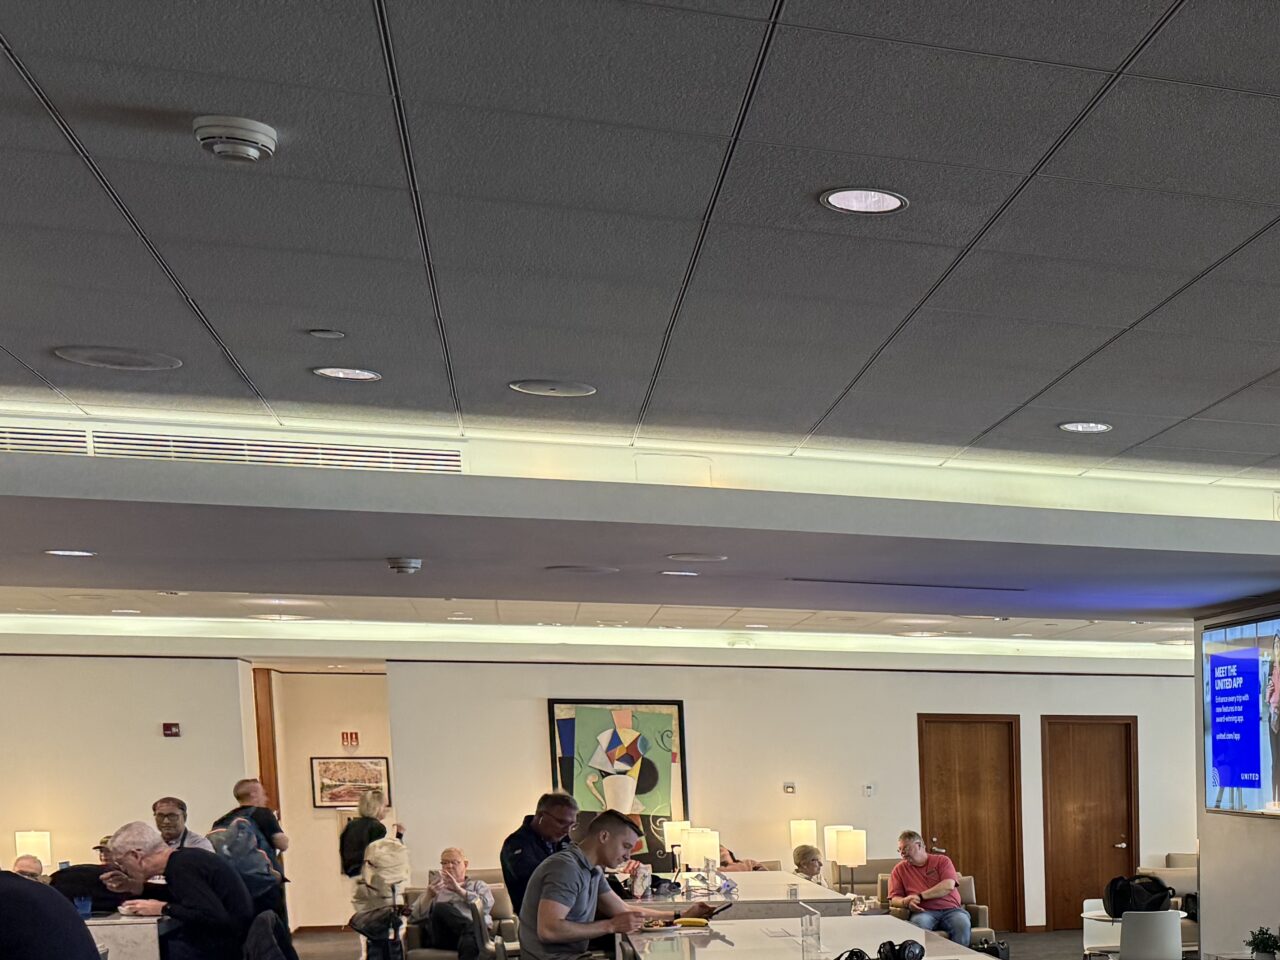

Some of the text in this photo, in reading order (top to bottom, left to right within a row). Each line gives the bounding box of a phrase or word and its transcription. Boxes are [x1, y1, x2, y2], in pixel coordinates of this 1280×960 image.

[1215, 665, 1237, 678] MEET THE
[1215, 677, 1243, 690] UNITED APP
